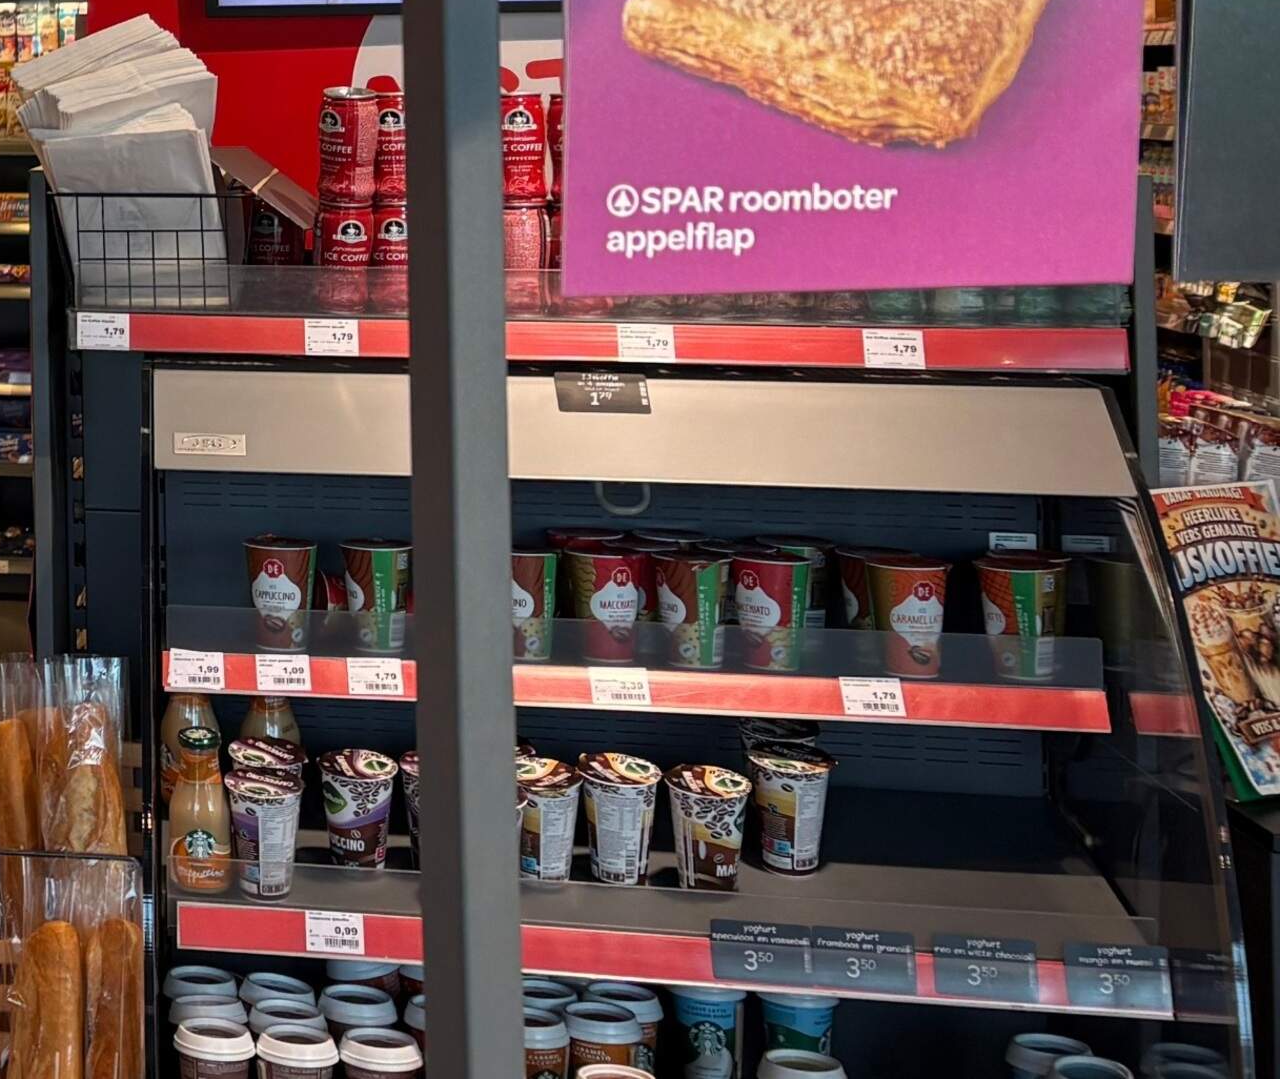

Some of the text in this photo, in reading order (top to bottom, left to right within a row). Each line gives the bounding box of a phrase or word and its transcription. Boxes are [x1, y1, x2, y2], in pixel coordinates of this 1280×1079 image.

[641, 183, 898, 216] SPAR roomboter
[605, 221, 756, 259] appelflap
[103, 326, 126, 337] 1,79
[331, 331, 354, 344] 1,79
[892, 344, 918, 356] 1,79
[1175, 523, 1259, 546] VERS GEMAAKTE
[254, 590, 296, 602] CAPPUCCINO
[198, 665, 220, 675] 1,99
[374, 672, 397, 682] 1,79
[871, 691, 897, 701] 1,79
[334, 926, 359, 938] 0,99
[743, 925, 777, 935] yoghurt
[845, 931, 880, 942] yoghurt
[862, 942, 875, 951] en
[966, 938, 1001, 950] yoghurt
[1096, 947, 1132, 958] yoghurt
